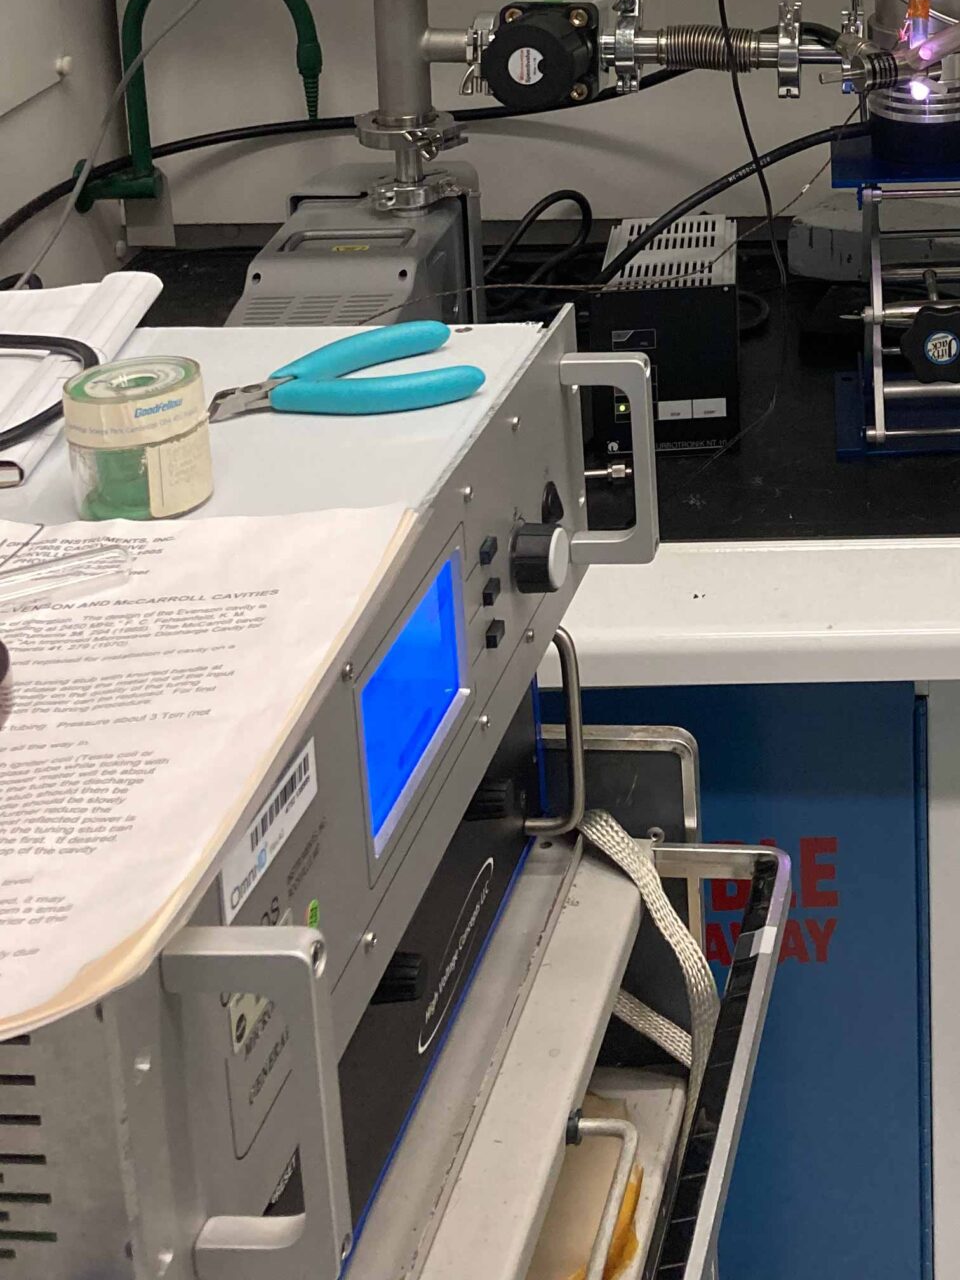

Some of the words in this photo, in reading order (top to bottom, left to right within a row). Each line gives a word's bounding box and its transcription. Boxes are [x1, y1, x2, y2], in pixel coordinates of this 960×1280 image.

[656, 441, 705, 449] URBOTRONIK
[77, 600, 111, 608] AND
[113, 595, 206, 606] McCARROLL
[211, 589, 280, 600] CAVITIES
